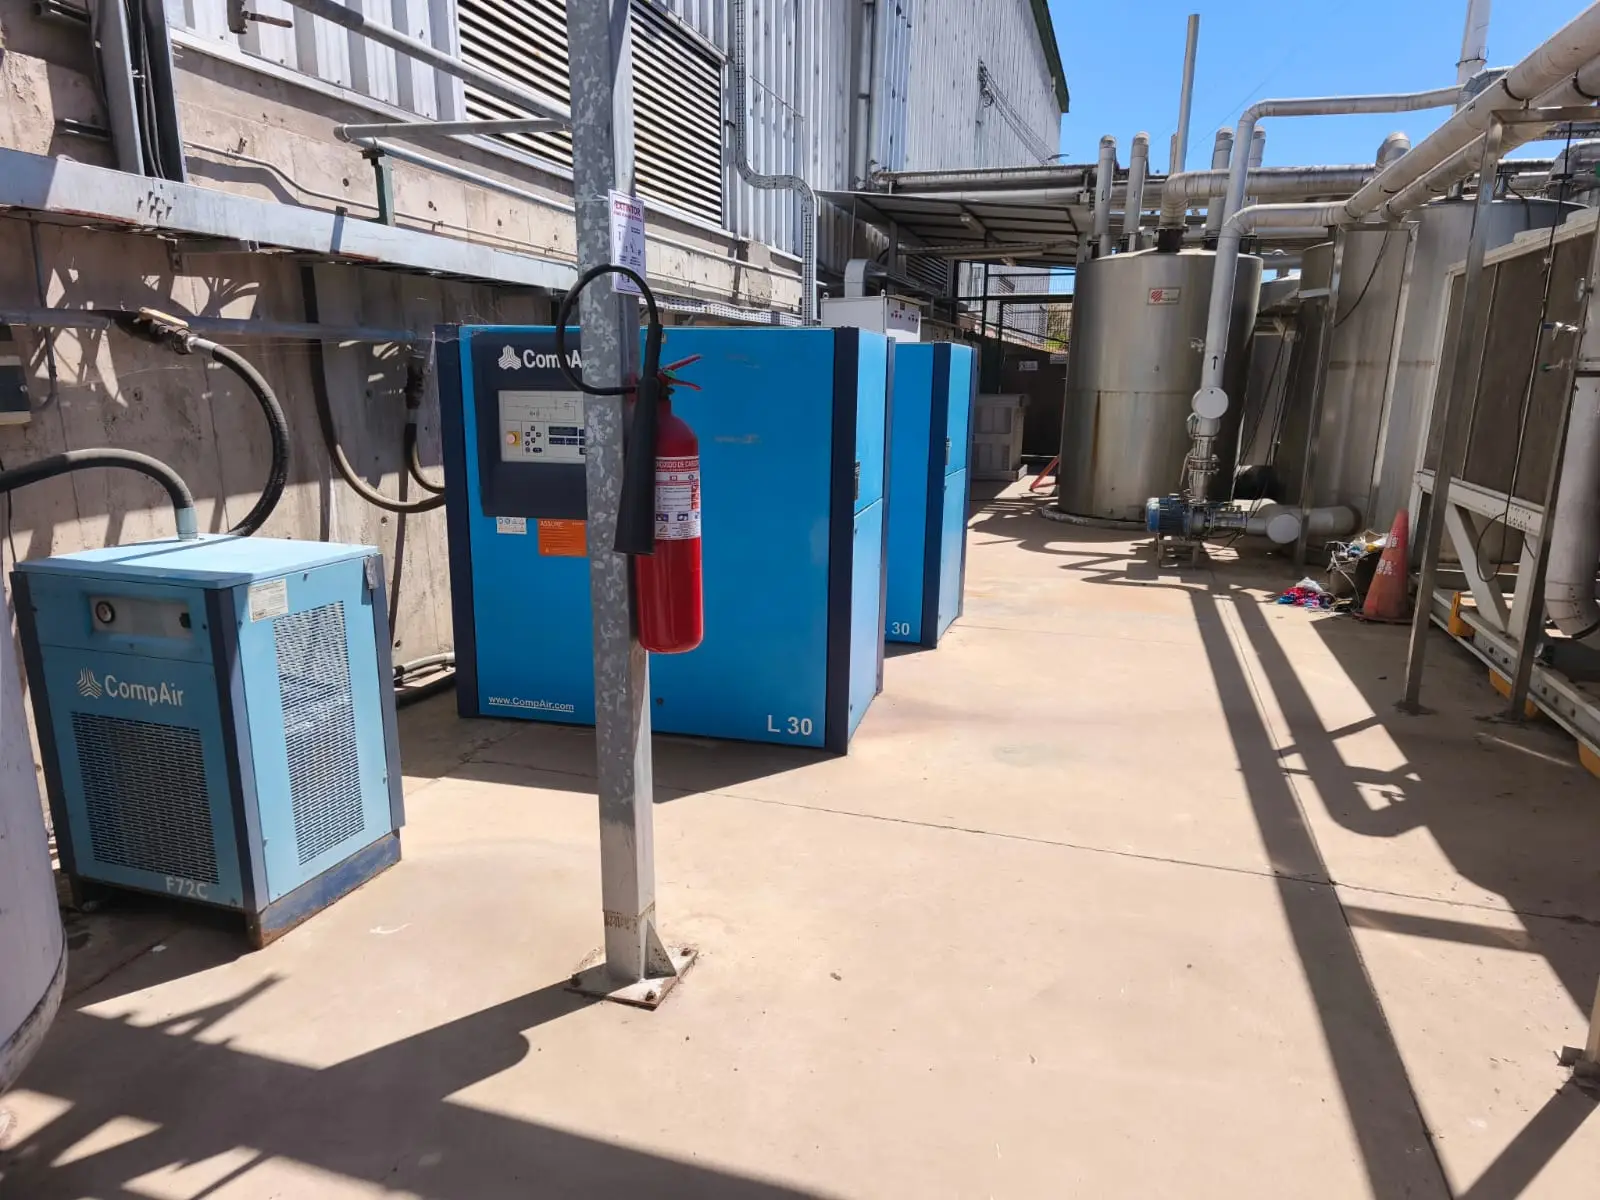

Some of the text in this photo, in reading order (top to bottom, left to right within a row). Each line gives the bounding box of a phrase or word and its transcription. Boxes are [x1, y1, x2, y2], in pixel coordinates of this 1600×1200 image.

[891, 621, 911, 636] 30
[104, 674, 184, 706] CompAir
[488, 695, 575, 713] www.CompAir.com
[767, 714, 813, 736] L 30
[166, 876, 208, 900] F72C
